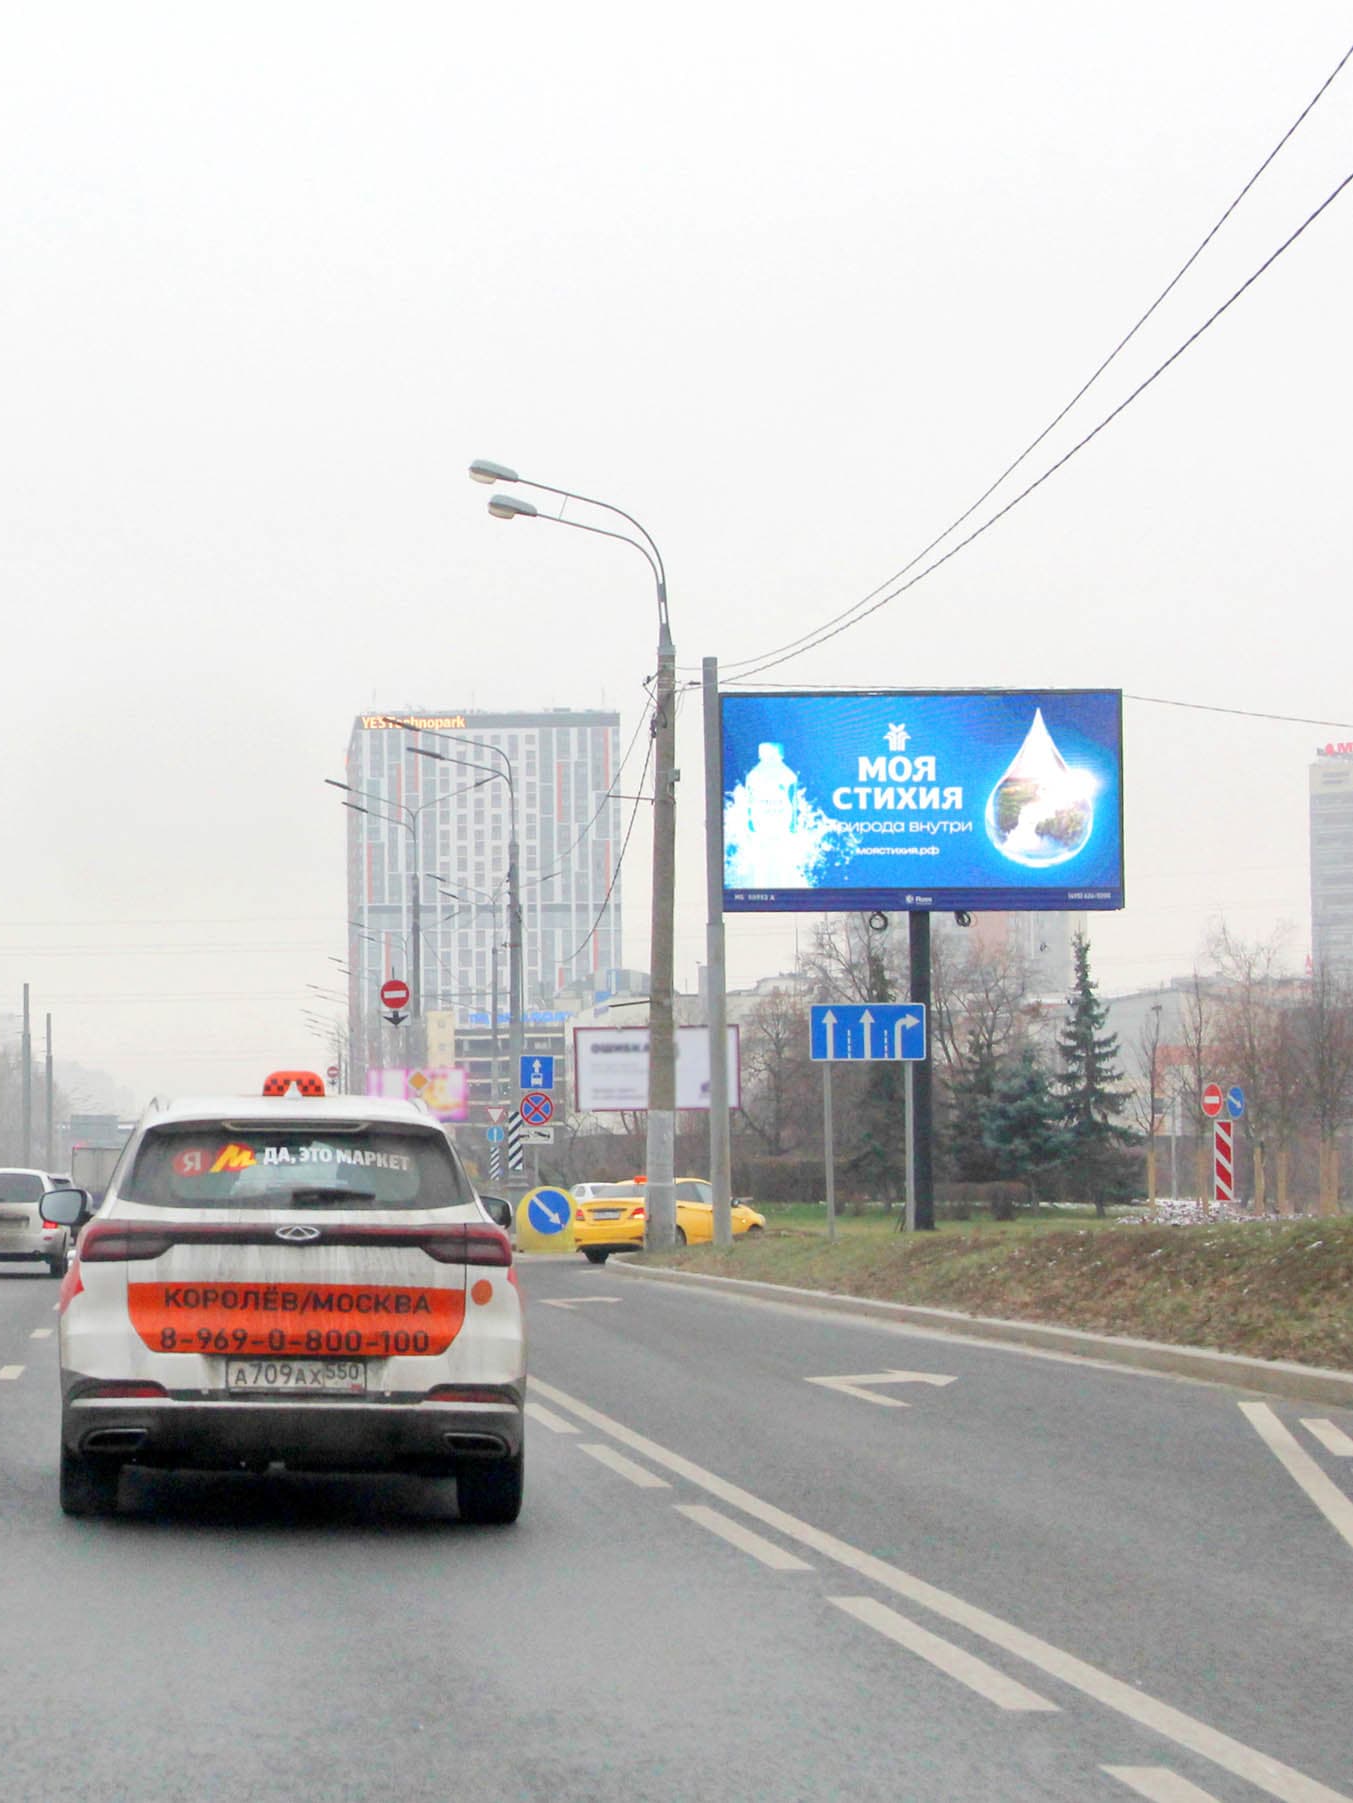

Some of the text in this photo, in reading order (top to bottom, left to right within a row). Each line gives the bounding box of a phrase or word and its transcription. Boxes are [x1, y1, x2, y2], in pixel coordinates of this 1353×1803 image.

[361, 716, 386, 729] YES
[858, 756, 937, 782] МОЯ
[832, 787, 963, 810] СТИХИЯ
[831, 821, 973, 835] рирода внутри
[183, 1152, 201, 1172] Я
[263, 1147, 296, 1165] ДА,
[299, 1147, 333, 1164] ЭТО
[336, 1149, 412, 1171] МАРКЕТ
[164, 1287, 432, 1315] КОРОЛЁВ/МОСКВА
[160, 1327, 430, 1354] 8-969-0-800-100
